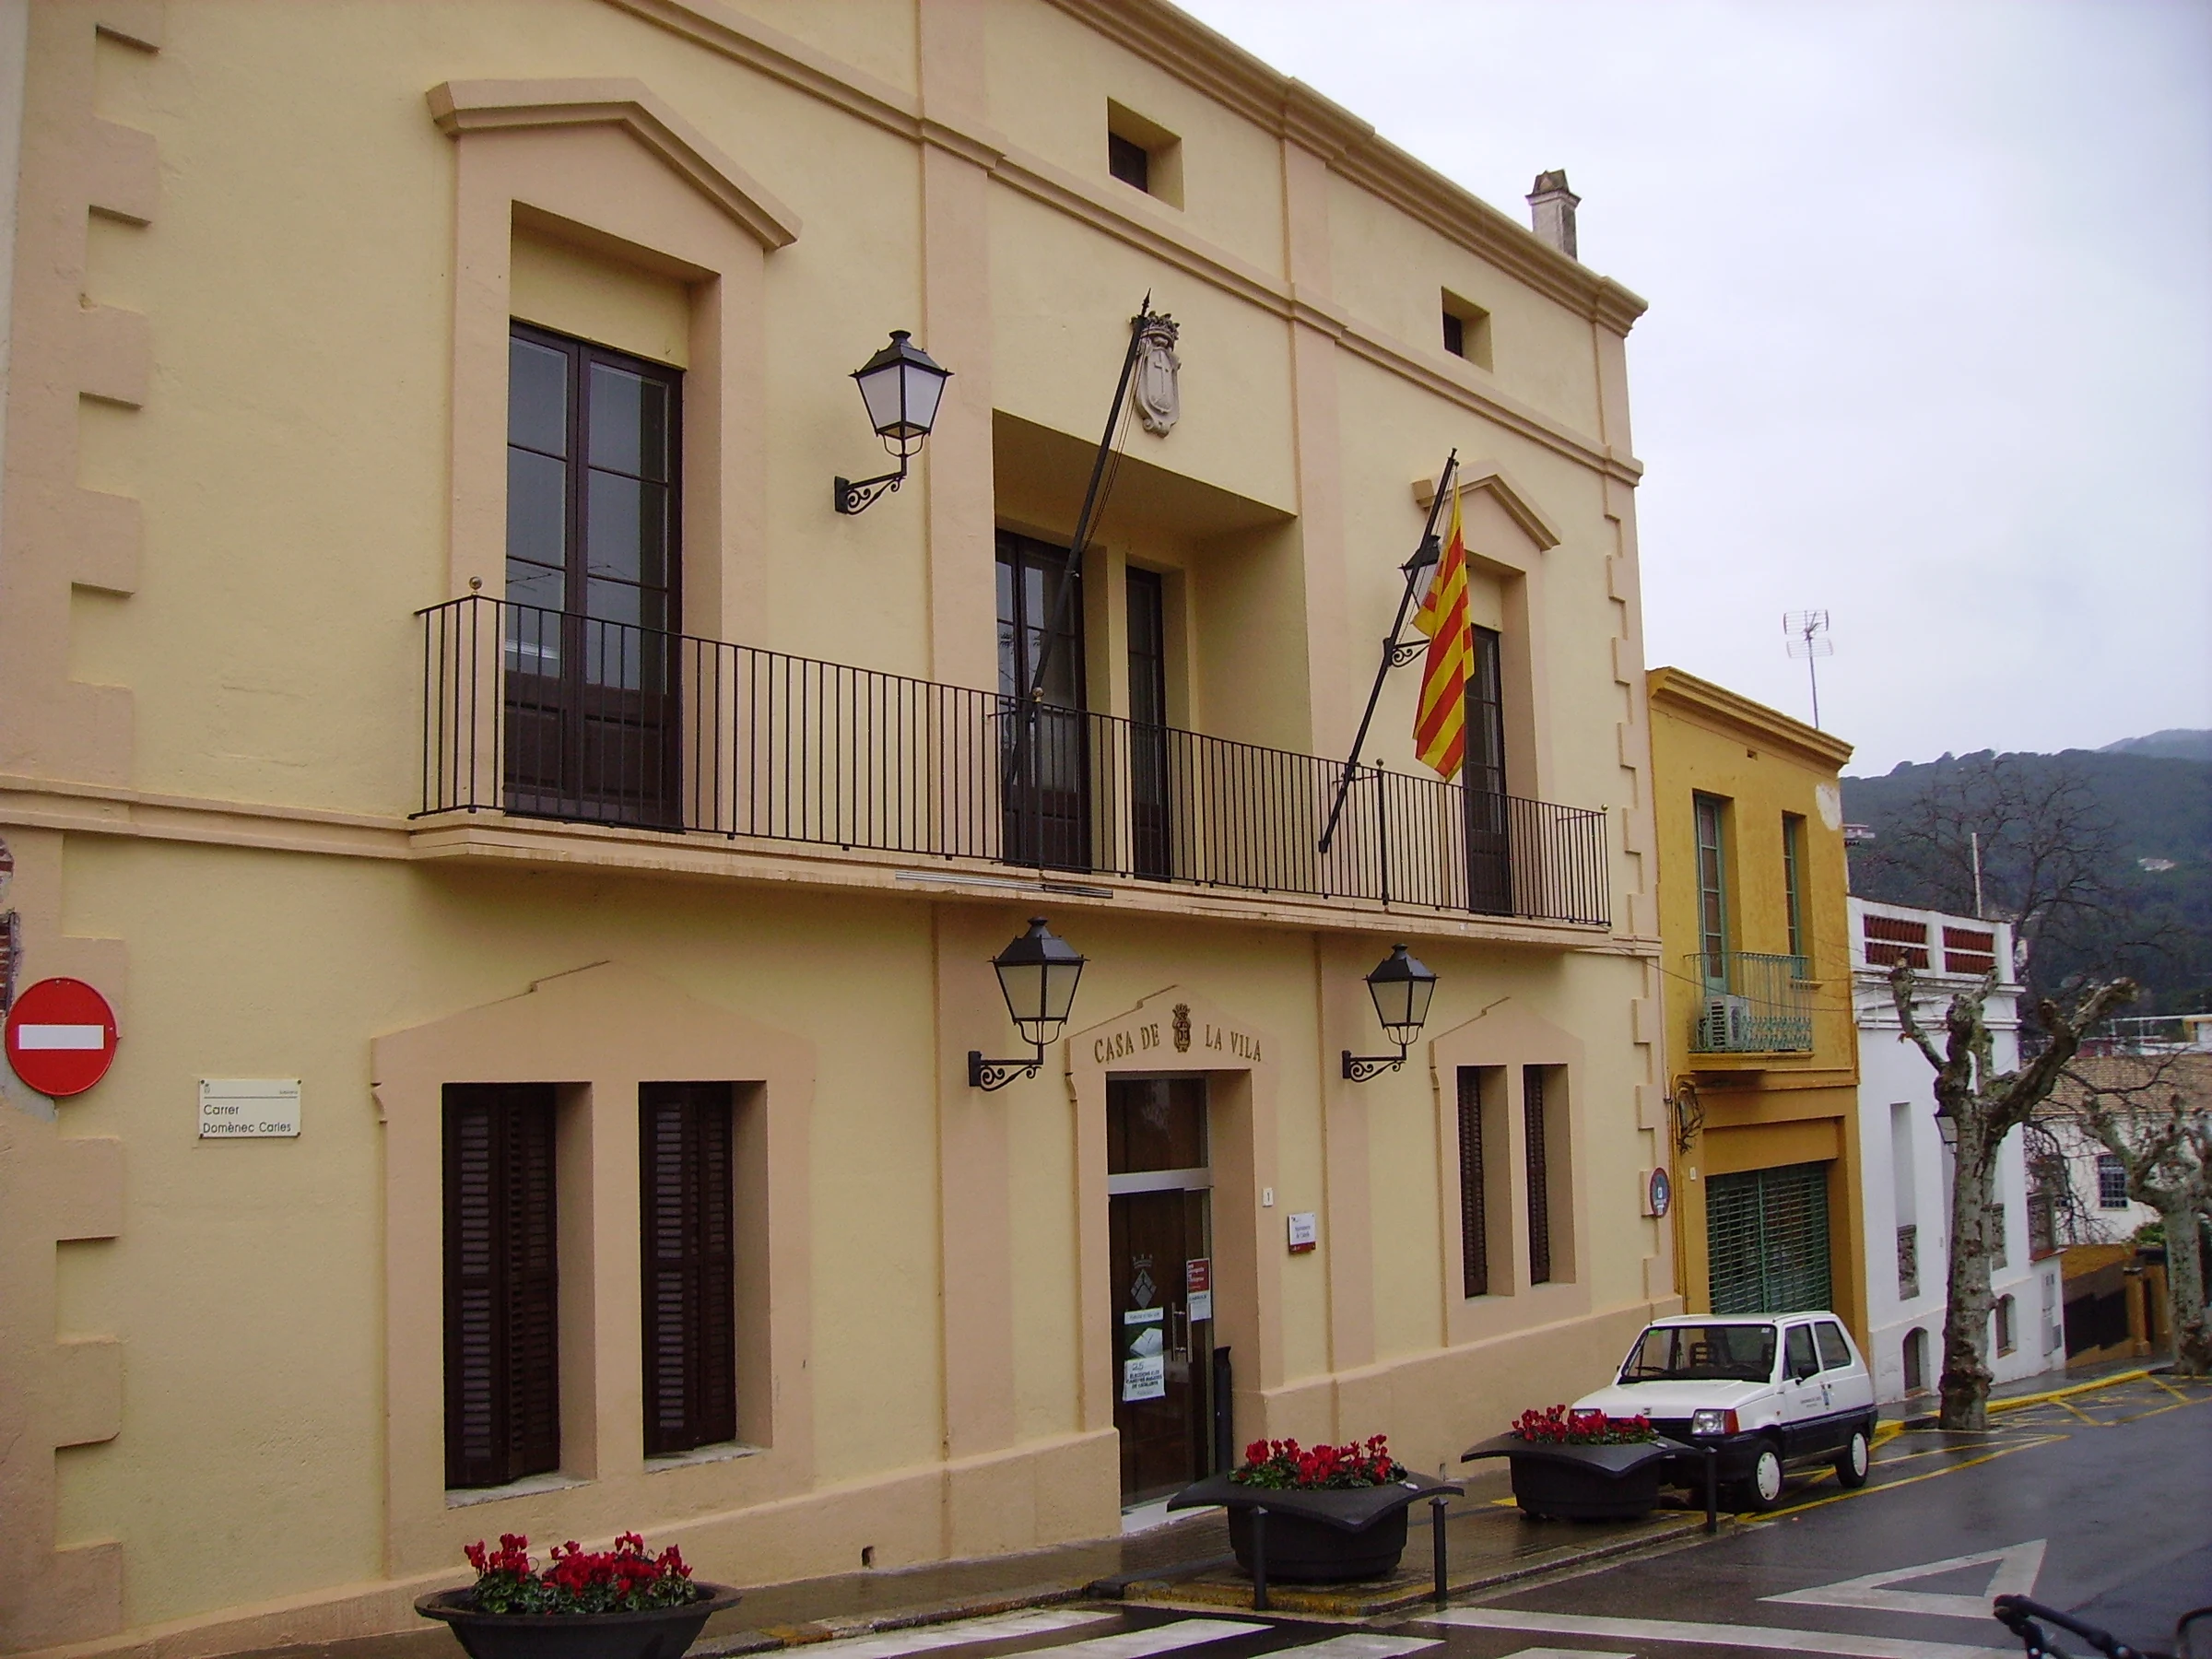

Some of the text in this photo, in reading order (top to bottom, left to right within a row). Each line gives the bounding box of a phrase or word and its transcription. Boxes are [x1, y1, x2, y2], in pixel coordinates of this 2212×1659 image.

[1094, 1023, 1262, 1064] CASA DE LA VILA
[203, 1104, 240, 1115] Carrer
[203, 1122, 291, 1134] Domènec Carles
